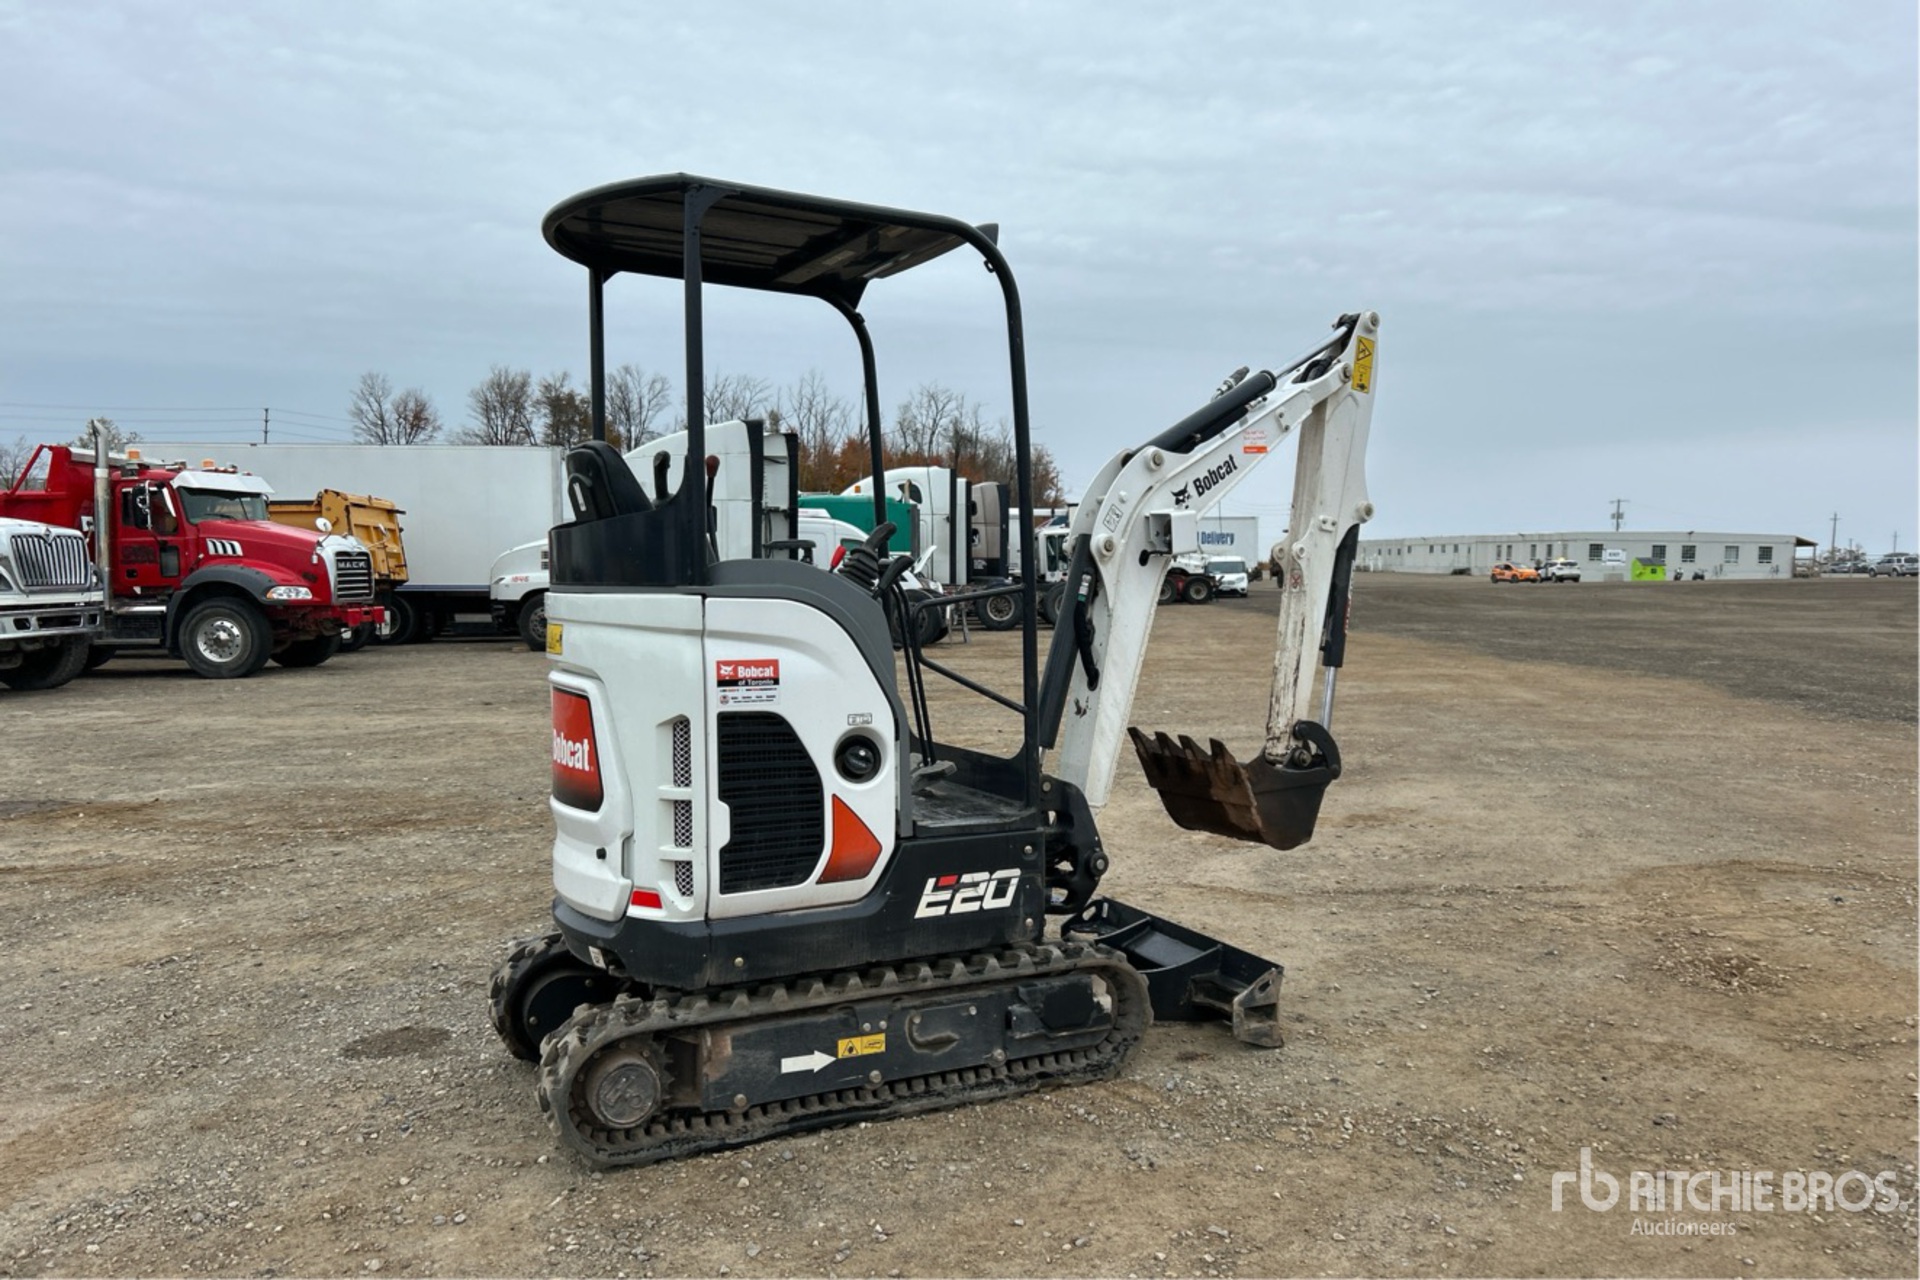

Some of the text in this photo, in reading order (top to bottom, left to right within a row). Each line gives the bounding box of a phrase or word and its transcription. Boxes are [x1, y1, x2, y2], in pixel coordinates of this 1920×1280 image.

[1193, 454, 1238, 497] Bobcat
[1201, 531, 1234, 546] Delivery
[337, 561, 368, 569] MACK
[737, 665, 775, 679] Bobcat
[914, 868, 1022, 919] E20
